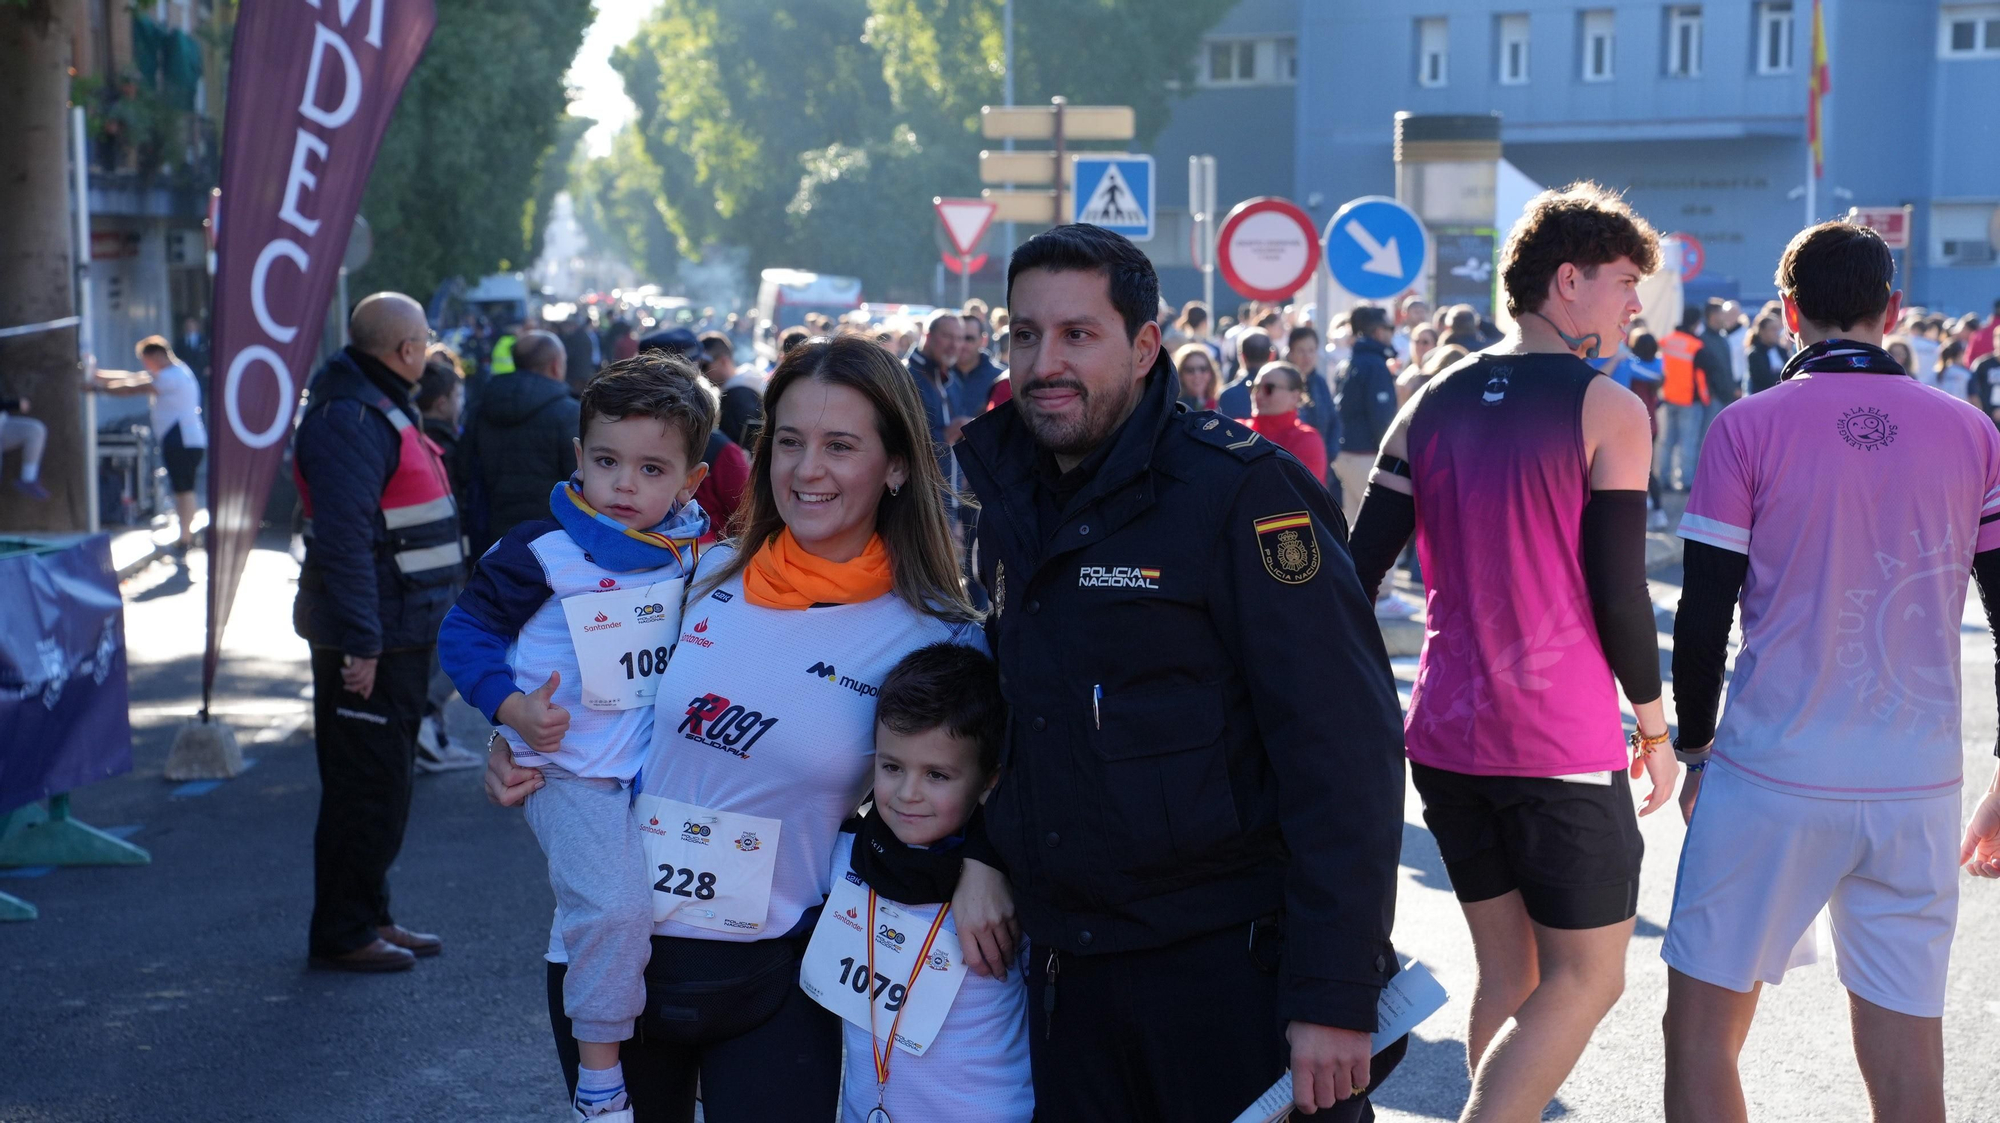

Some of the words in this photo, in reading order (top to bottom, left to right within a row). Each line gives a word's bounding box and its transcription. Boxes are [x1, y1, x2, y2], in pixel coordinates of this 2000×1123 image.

[1080, 566, 1142, 578] POLICIA
[1264, 548, 1292, 581] POLICIA
[1295, 540, 1318, 581] NACIONAL
[1078, 577, 1160, 589] NACIONAL
[584, 621, 622, 632] Santander
[619, 644, 676, 680] 108
[685, 733, 747, 758] SOLIDARIA
[653, 863, 717, 900] 228
[833, 910, 863, 933] Santander
[838, 956, 908, 1012] 1079
